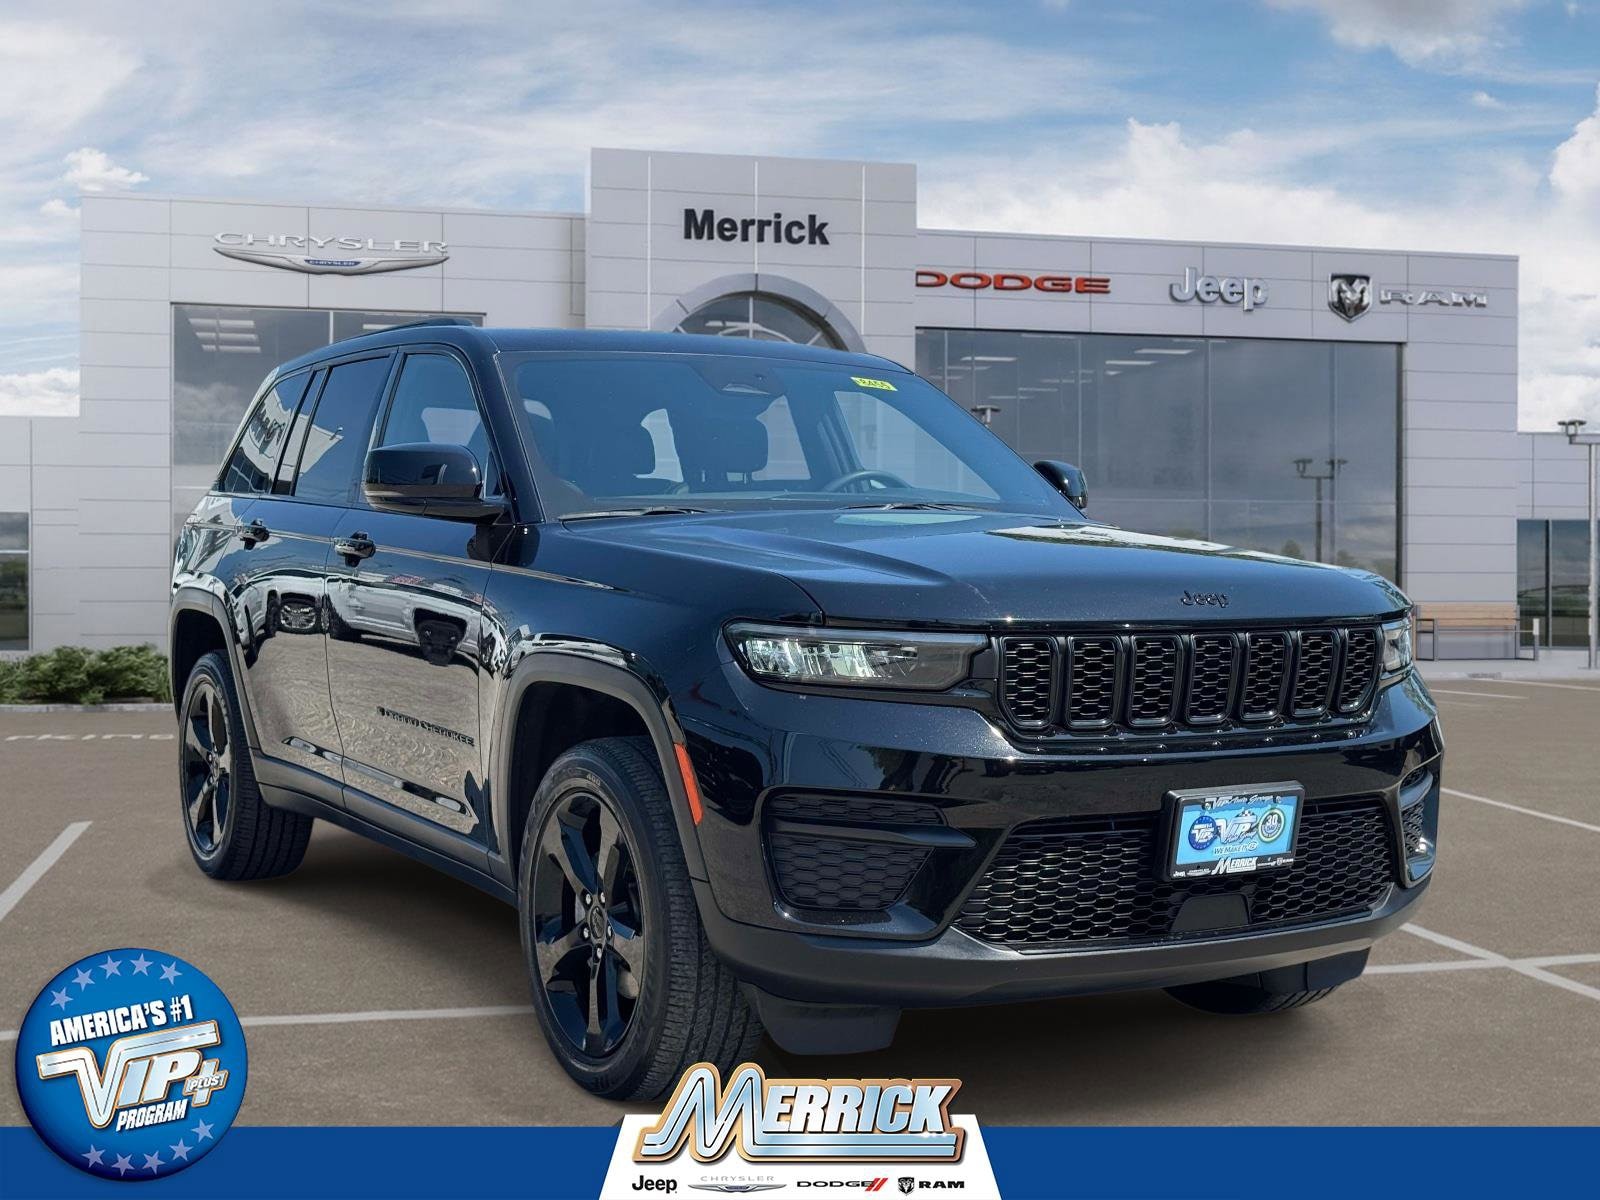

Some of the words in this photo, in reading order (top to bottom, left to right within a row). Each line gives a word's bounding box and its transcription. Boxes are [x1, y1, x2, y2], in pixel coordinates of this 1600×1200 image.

[684, 208, 830, 246] Merrick
[214, 232, 449, 254] CHRYSLER
[915, 270, 1110, 294] DODGE
[1170, 266, 1269, 312] Jeep
[1379, 289, 1488, 309] RAM
[1180, 590, 1229, 609] Jeep
[1211, 857, 1258, 875] MERRICK
